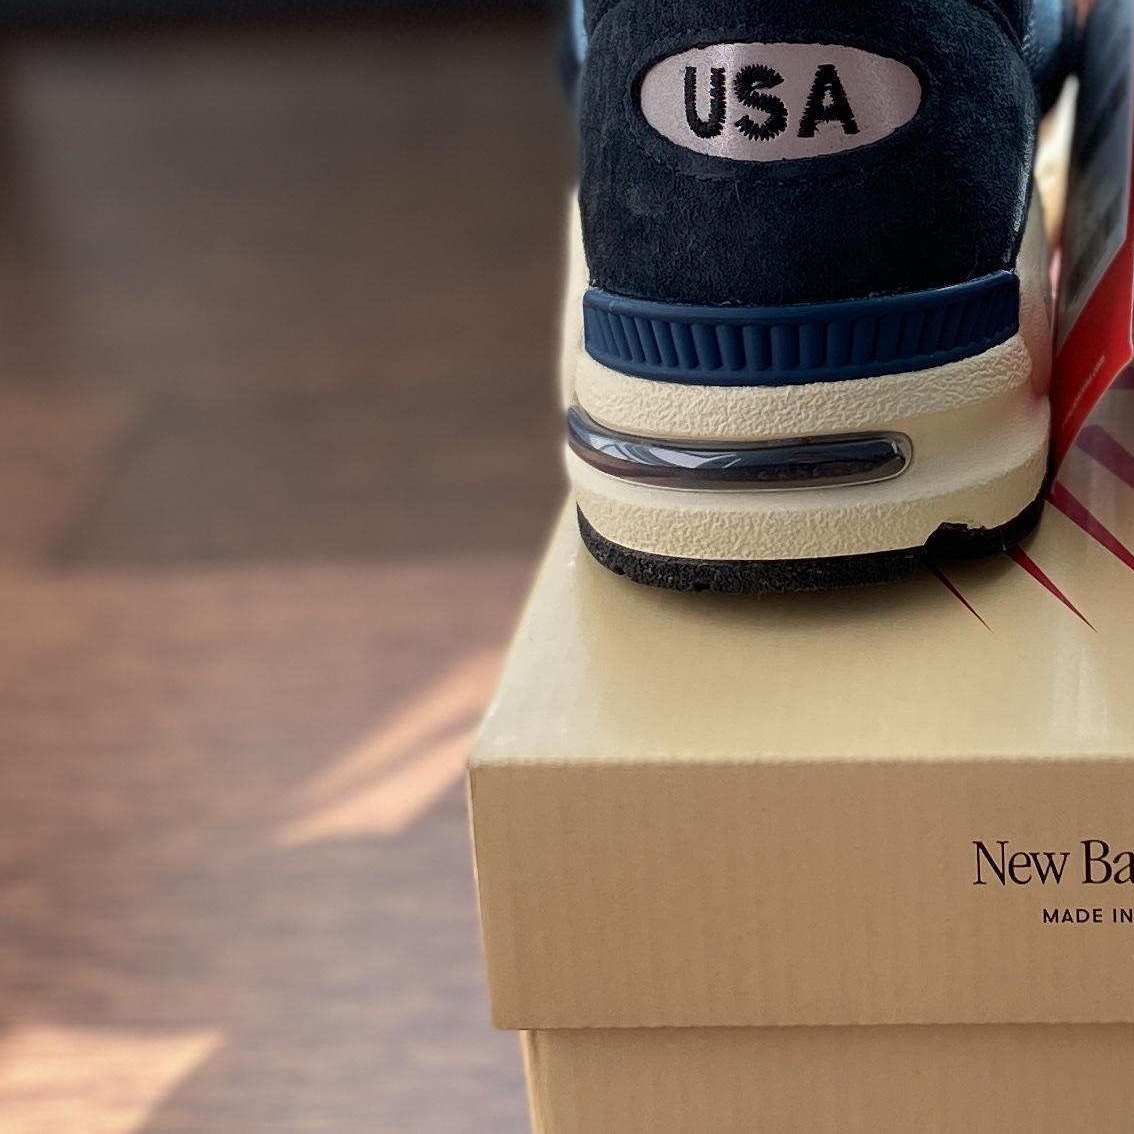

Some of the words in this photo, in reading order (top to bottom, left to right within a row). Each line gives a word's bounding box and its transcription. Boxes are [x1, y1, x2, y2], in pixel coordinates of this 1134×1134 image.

[683, 62, 861, 142] USA
[972, 839, 1072, 887] New
[1042, 907, 1104, 924] MADE
[1112, 907, 1134, 924] IN
